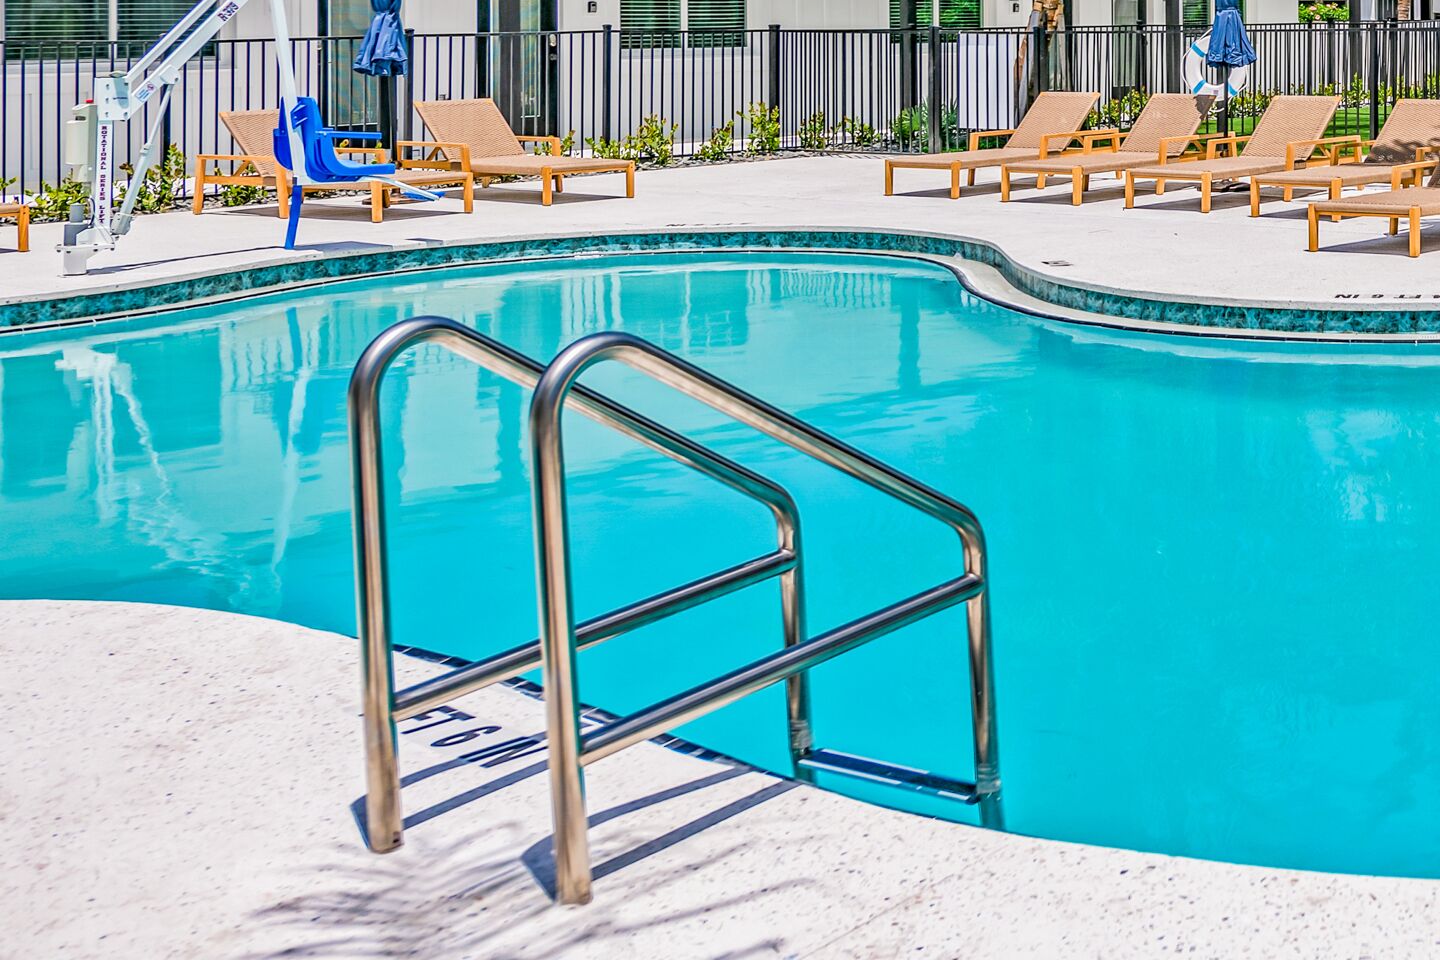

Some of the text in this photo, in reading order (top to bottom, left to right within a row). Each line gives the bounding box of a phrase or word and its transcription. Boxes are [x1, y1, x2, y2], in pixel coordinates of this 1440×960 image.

[100, 125, 108, 170] ROTATIONAL
[98, 205, 106, 224] LIFT
[400, 705, 476, 735] FT
[430, 725, 503, 747] 6
